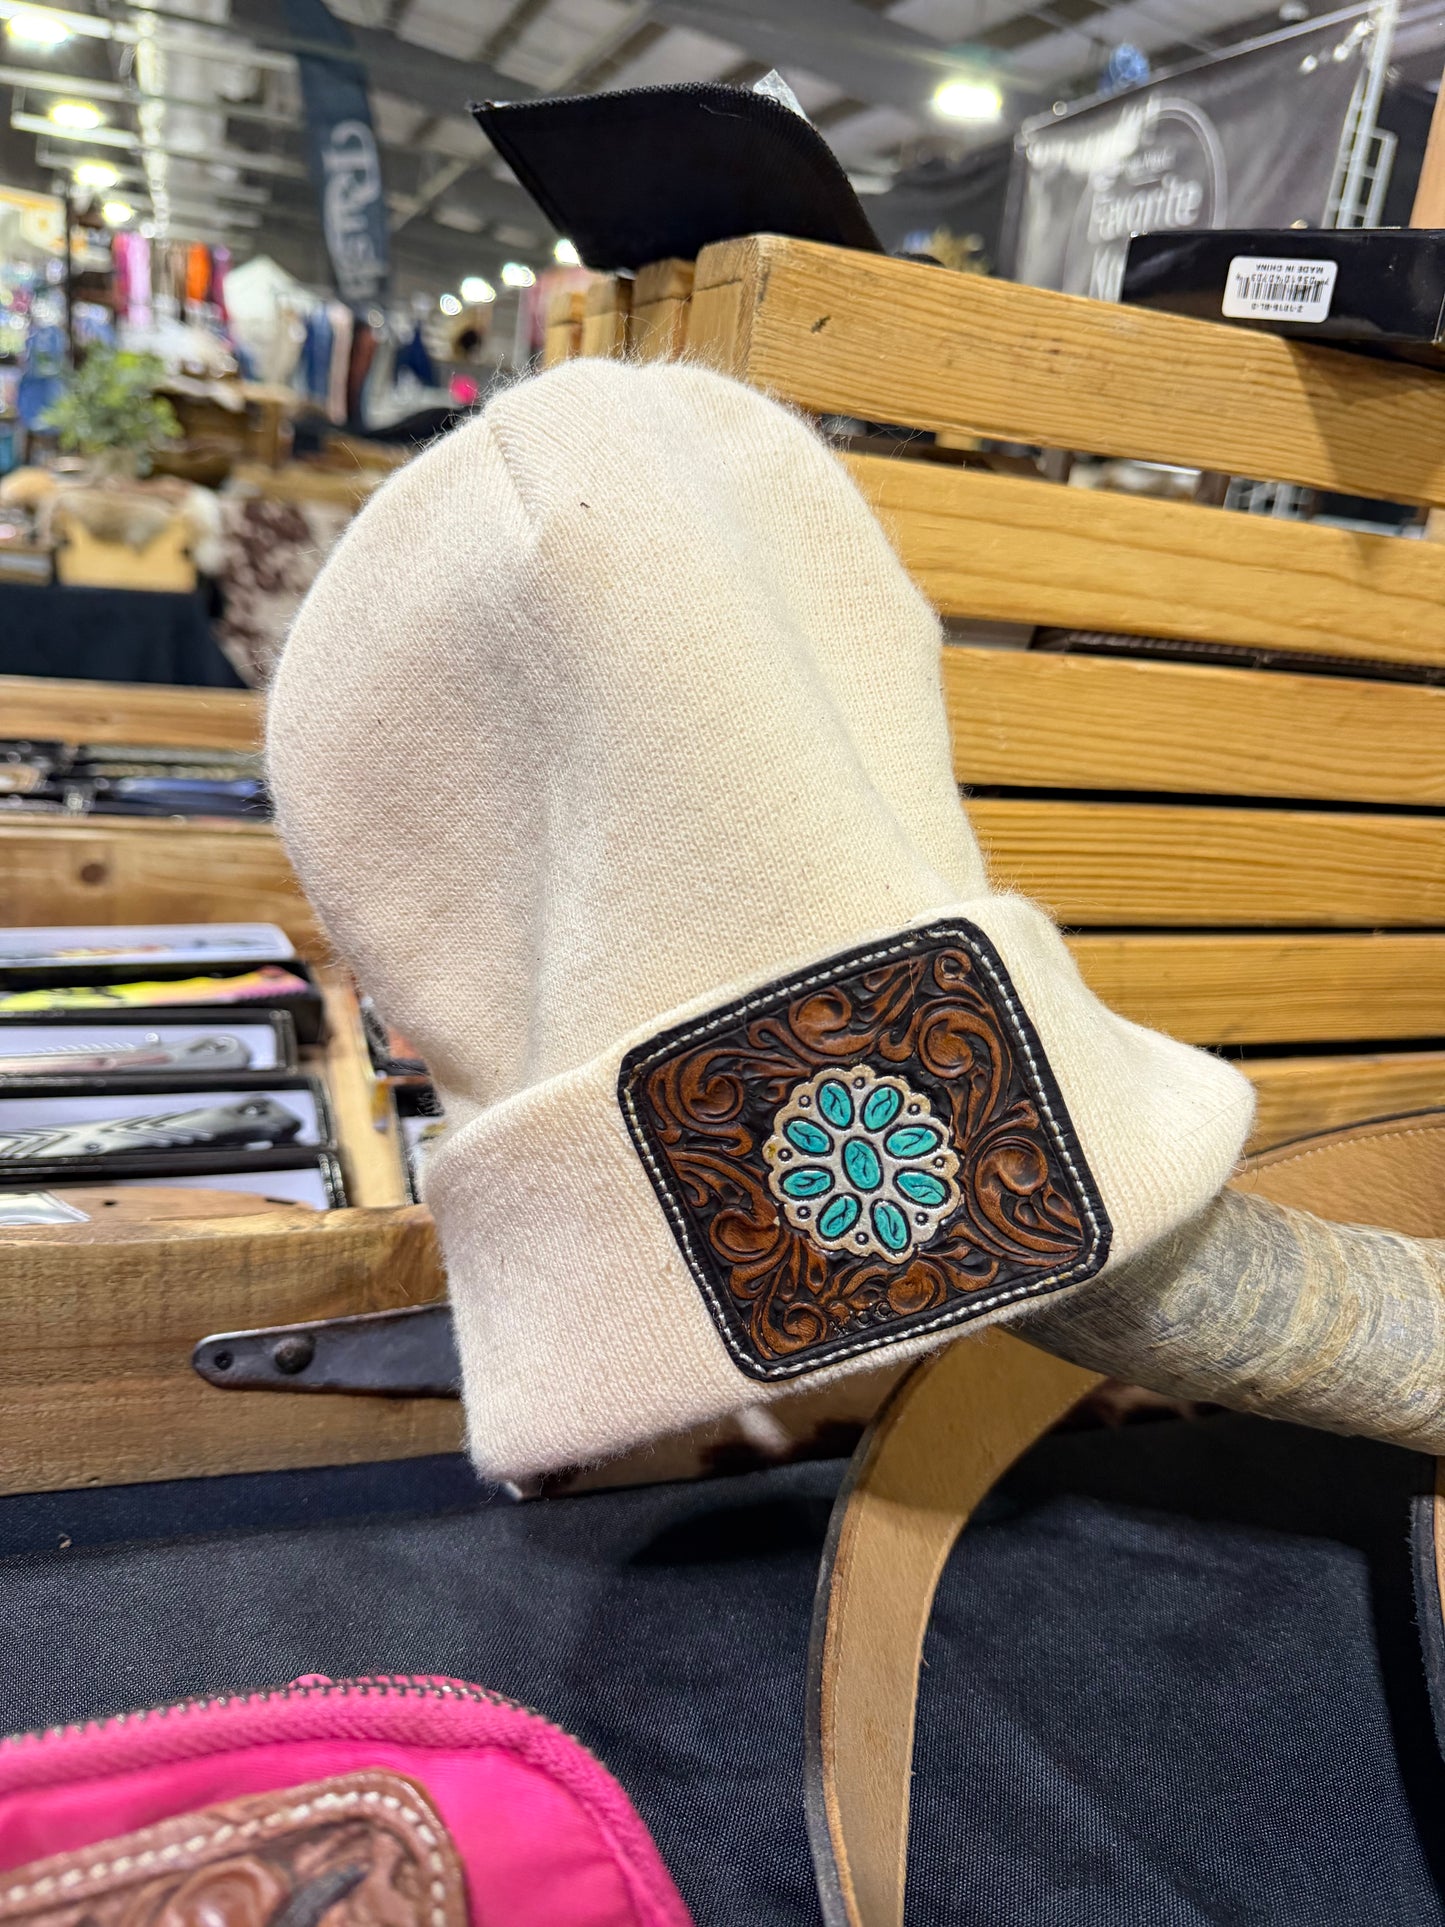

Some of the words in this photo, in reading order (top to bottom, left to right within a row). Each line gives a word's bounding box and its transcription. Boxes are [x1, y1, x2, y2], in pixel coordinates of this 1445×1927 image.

[1256, 263, 1283, 273] CHINA
[1285, 264, 1295, 273] IN
[1299, 265, 1324, 274] MADE
